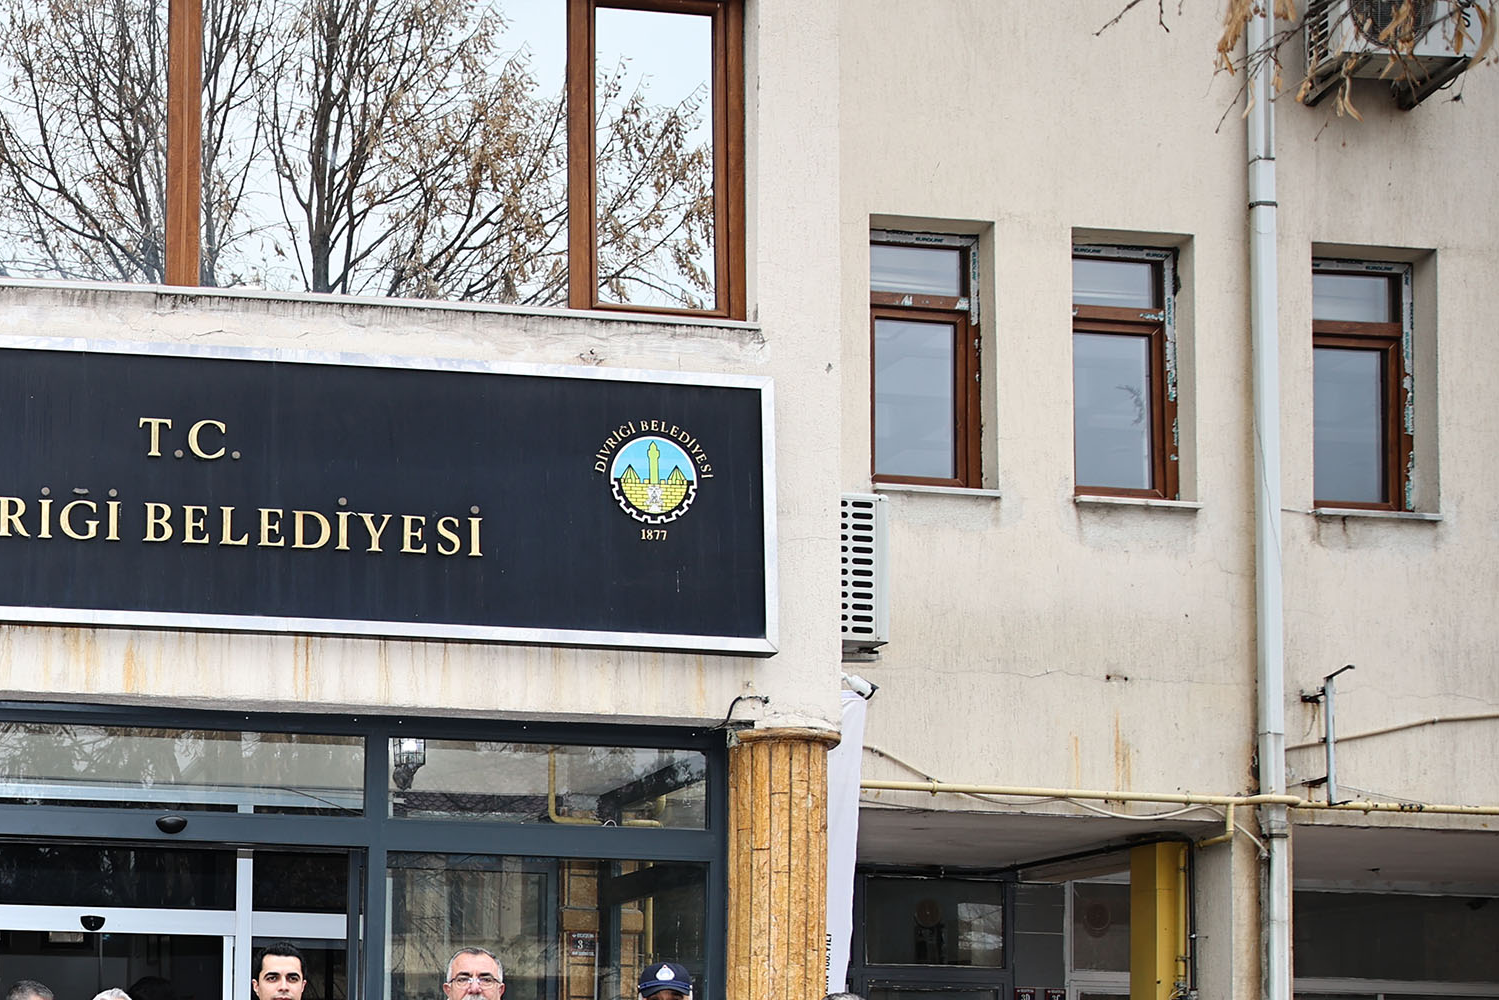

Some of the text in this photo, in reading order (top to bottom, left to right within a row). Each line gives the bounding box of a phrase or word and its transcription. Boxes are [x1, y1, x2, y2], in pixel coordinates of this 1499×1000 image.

[139, 417, 242, 460] T.C.
[594, 420, 714, 478] DİVRİĞİ BELEDİYESİ
[142, 497, 483, 557] BELEDİYESİ
[640, 528, 668, 541] 1877
[577, 939, 584, 950] 3
